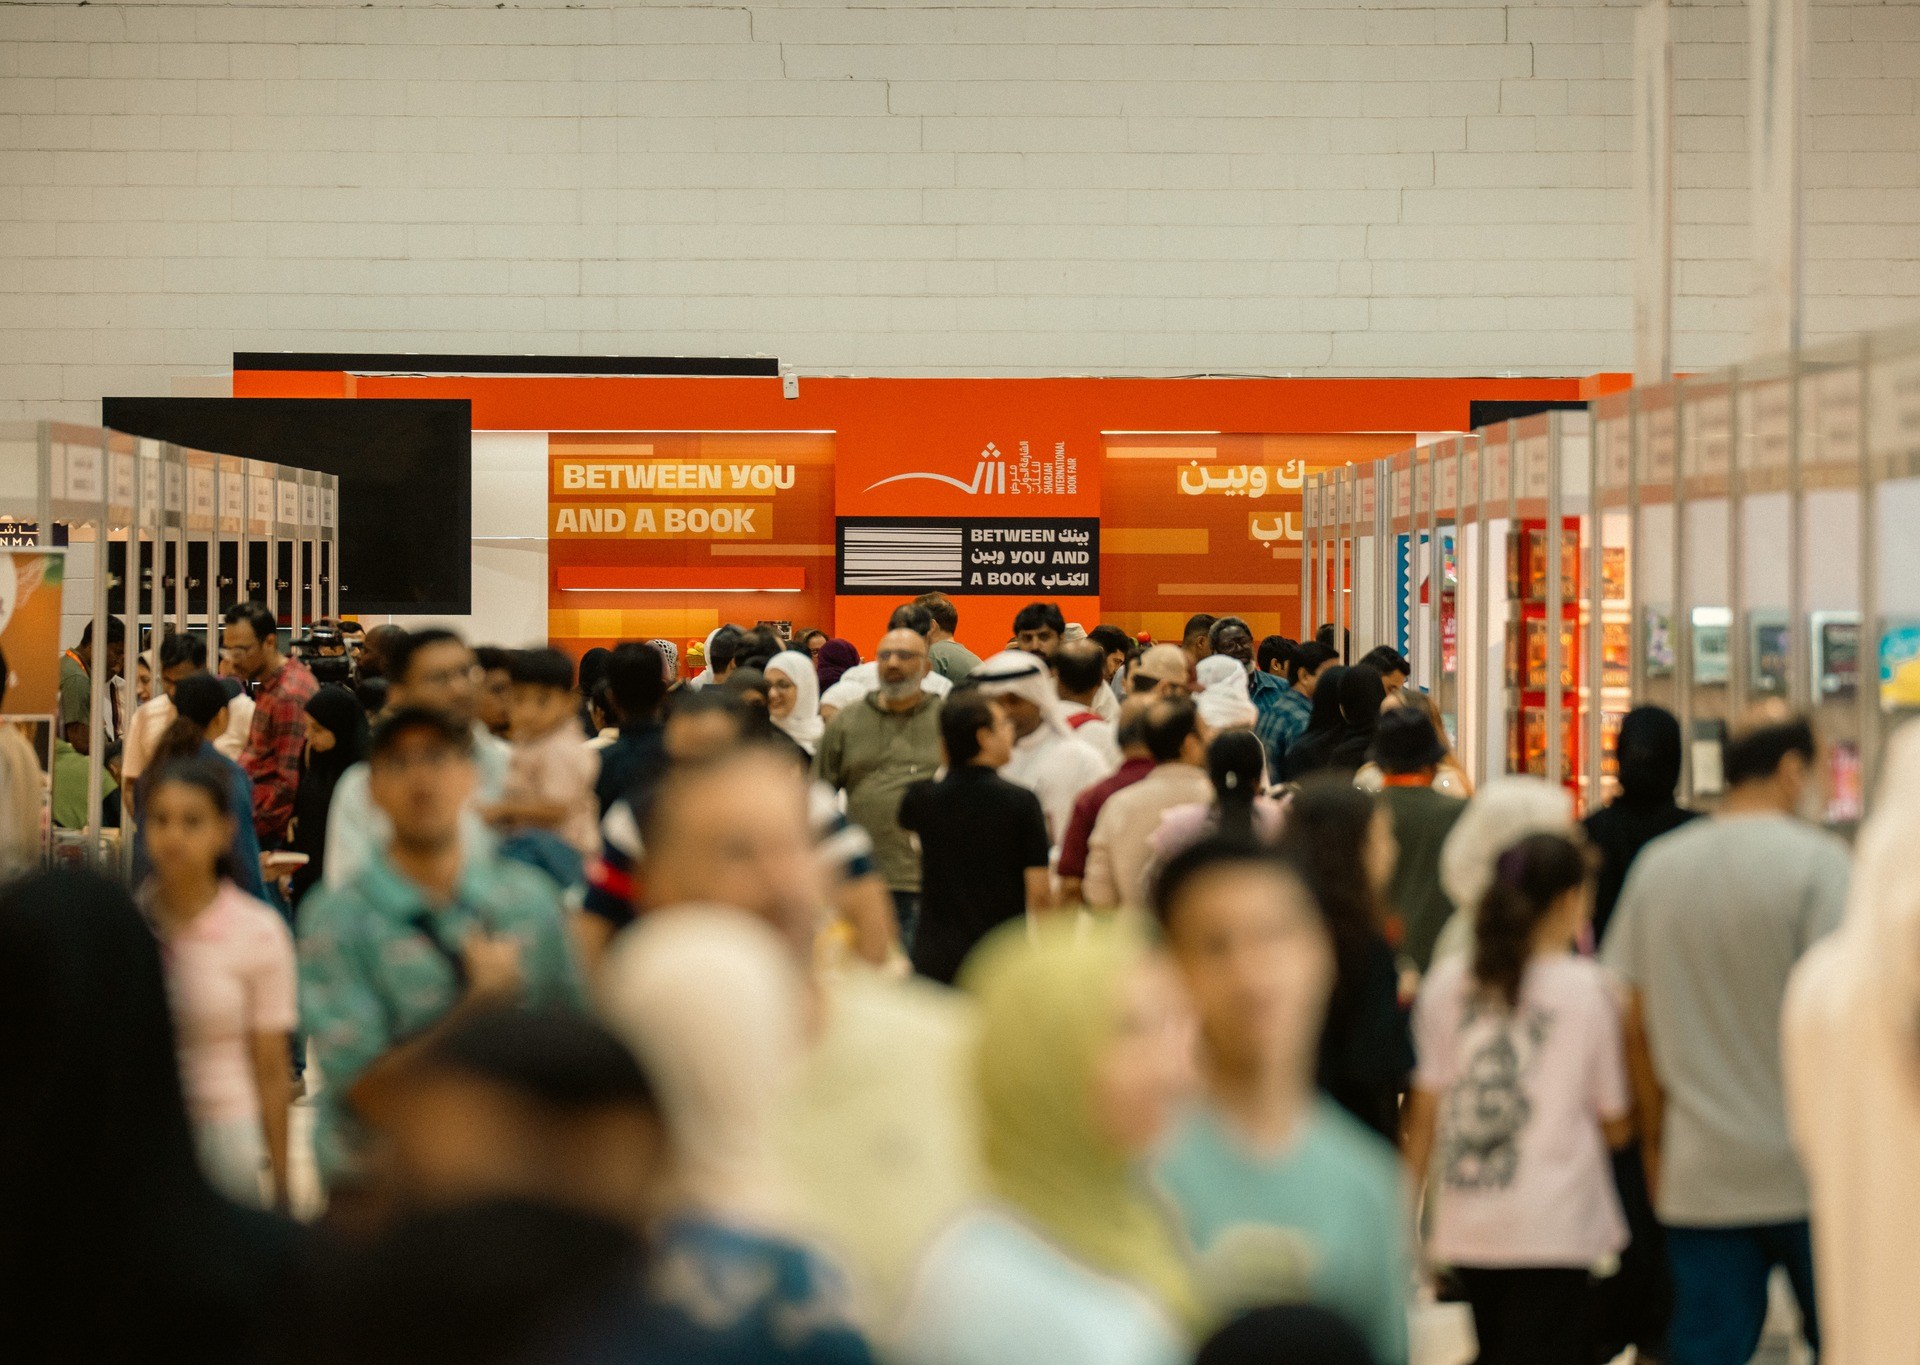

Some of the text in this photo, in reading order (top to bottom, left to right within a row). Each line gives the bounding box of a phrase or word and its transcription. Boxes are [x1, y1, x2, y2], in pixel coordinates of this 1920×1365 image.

[563, 464, 795, 490] BETWEEN YOU
[1043, 462, 1053, 495] SHARJAH
[1055, 441, 1065, 495] INTERNATIONAL
[1067, 457, 1077, 495] BOOK FAIR
[1180, 459, 1268, 498] وبين
[555, 508, 756, 533] AND A BOOK
[970, 529, 1055, 543] BETWEEN
[1058, 528, 1090, 547] بينك
[970, 548, 1005, 565] وبين
[1010, 550, 1089, 565] YOU AND
[970, 572, 1036, 586] A BOOK
[1041, 572, 1089, 590] الكتاب
